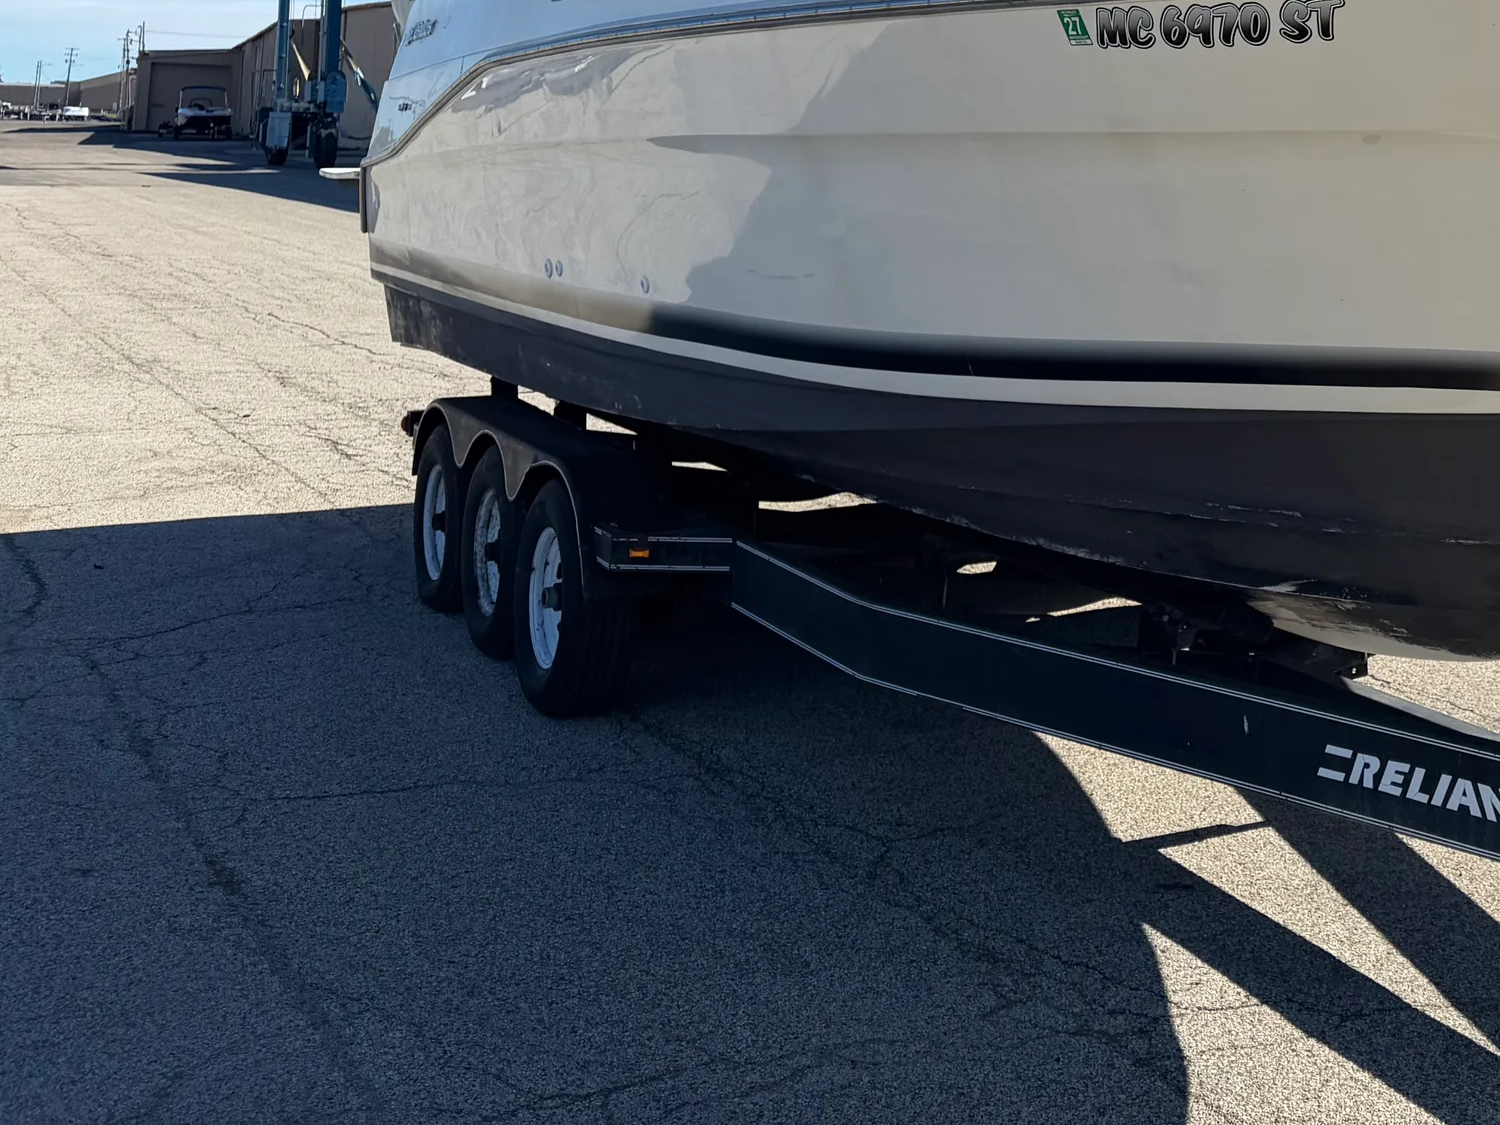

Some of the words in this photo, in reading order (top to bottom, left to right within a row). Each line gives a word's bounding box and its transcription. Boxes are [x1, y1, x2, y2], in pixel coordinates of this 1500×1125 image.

[1063, 16, 1082, 35] 27
[1096, 5, 1156, 49] MC
[1160, 2, 1271, 49] 6970
